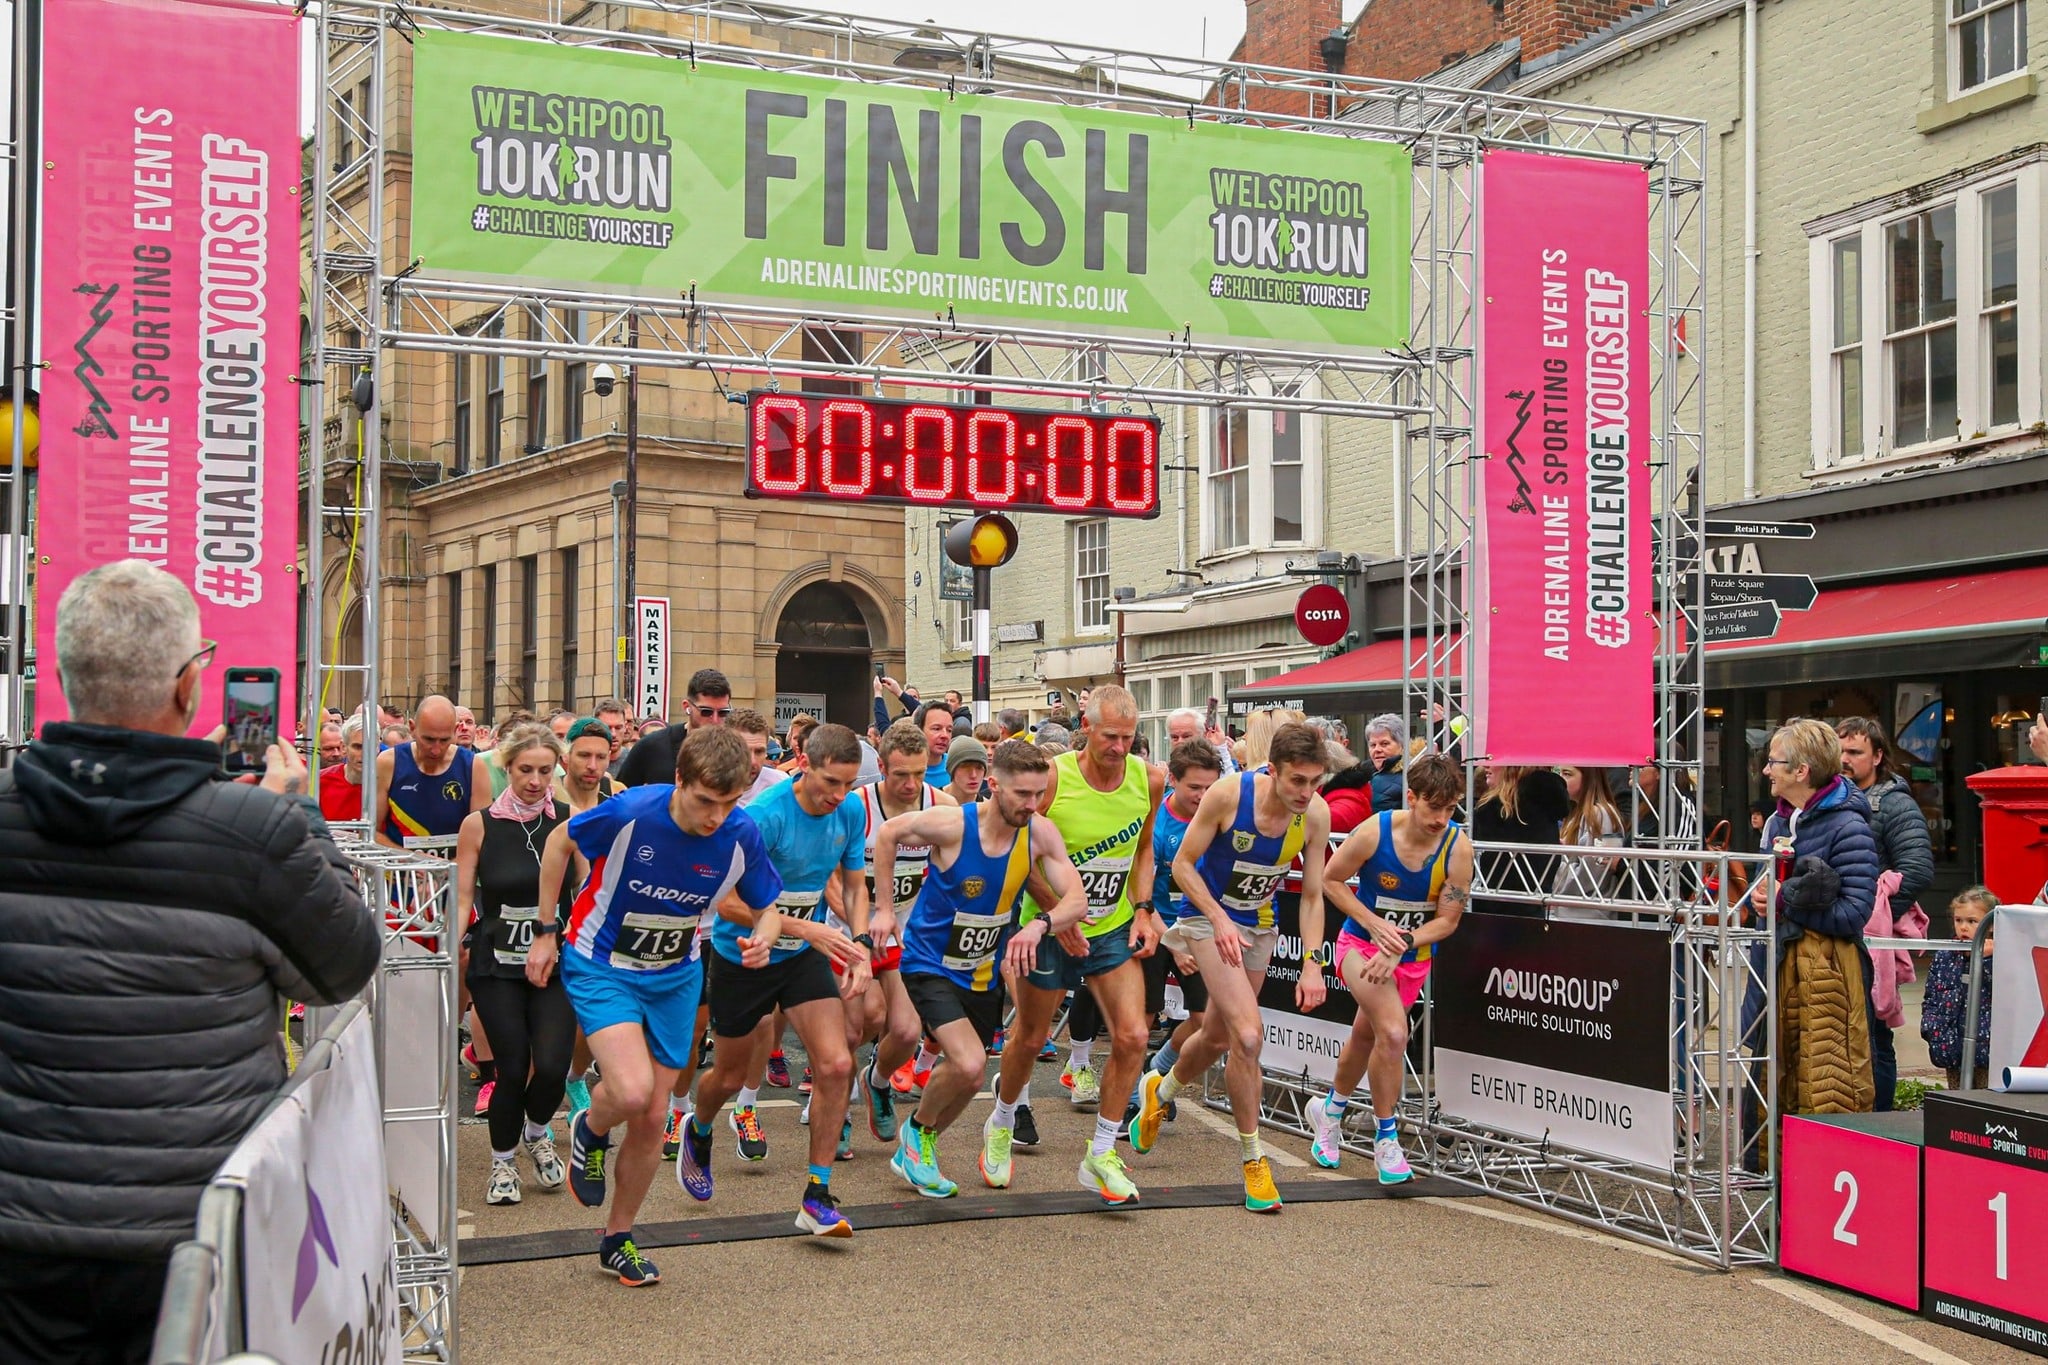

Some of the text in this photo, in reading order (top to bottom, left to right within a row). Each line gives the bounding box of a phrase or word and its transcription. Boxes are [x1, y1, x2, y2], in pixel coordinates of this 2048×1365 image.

[477, 90, 667, 147] WELSHPOOL
[475, 136, 667, 208] 10K RUN
[744, 89, 1148, 275] FINISH
[1213, 172, 1365, 219] WELSHPOOL
[473, 207, 673, 248] #CHALLENGEYOURSELF
[1213, 212, 1365, 274] 10K RUN
[760, 256, 1129, 314] ADRENALINESPORTINGEVENTS.CO.UK
[1210, 275, 1370, 310] #CHALLENGEYOURSELF
[128, 106, 174, 567] ENALINE SPORTING EVENTS
[201, 138, 264, 599] #CHALLENGEYOURSELF
[755, 397, 1153, 511] 00:00:00
[1542, 248, 1570, 661] ADRENALINE SPORTING EVENTS
[1589, 271, 1626, 645] #CHALLENGEYOURSELF
[1734, 524, 1780, 534] Retail Park
[1710, 578, 1764, 590] Puzzle Square
[1304, 609, 1342, 621] COSTA
[645, 608, 659, 676] MARKET
[1068, 816, 1144, 868] ELSHPOOL
[628, 879, 710, 905] CARDIFF
[1082, 872, 1121, 898] 246
[1237, 875, 1280, 895] 439
[505, 920, 534, 946] 70
[630, 928, 683, 954] 713
[958, 926, 1001, 952] 690
[1262, 1023, 1345, 1059] VENT BRAND
[1487, 1005, 1612, 1041] GRAPHIC SOLUTIONS
[1471, 1073, 1632, 1130] EVENT BRANDING
[1950, 1129, 2048, 1160] ADRENALINE SPORTING EVEN
[1833, 1170, 1859, 1247] 2
[1988, 1191, 2008, 1281] 1
